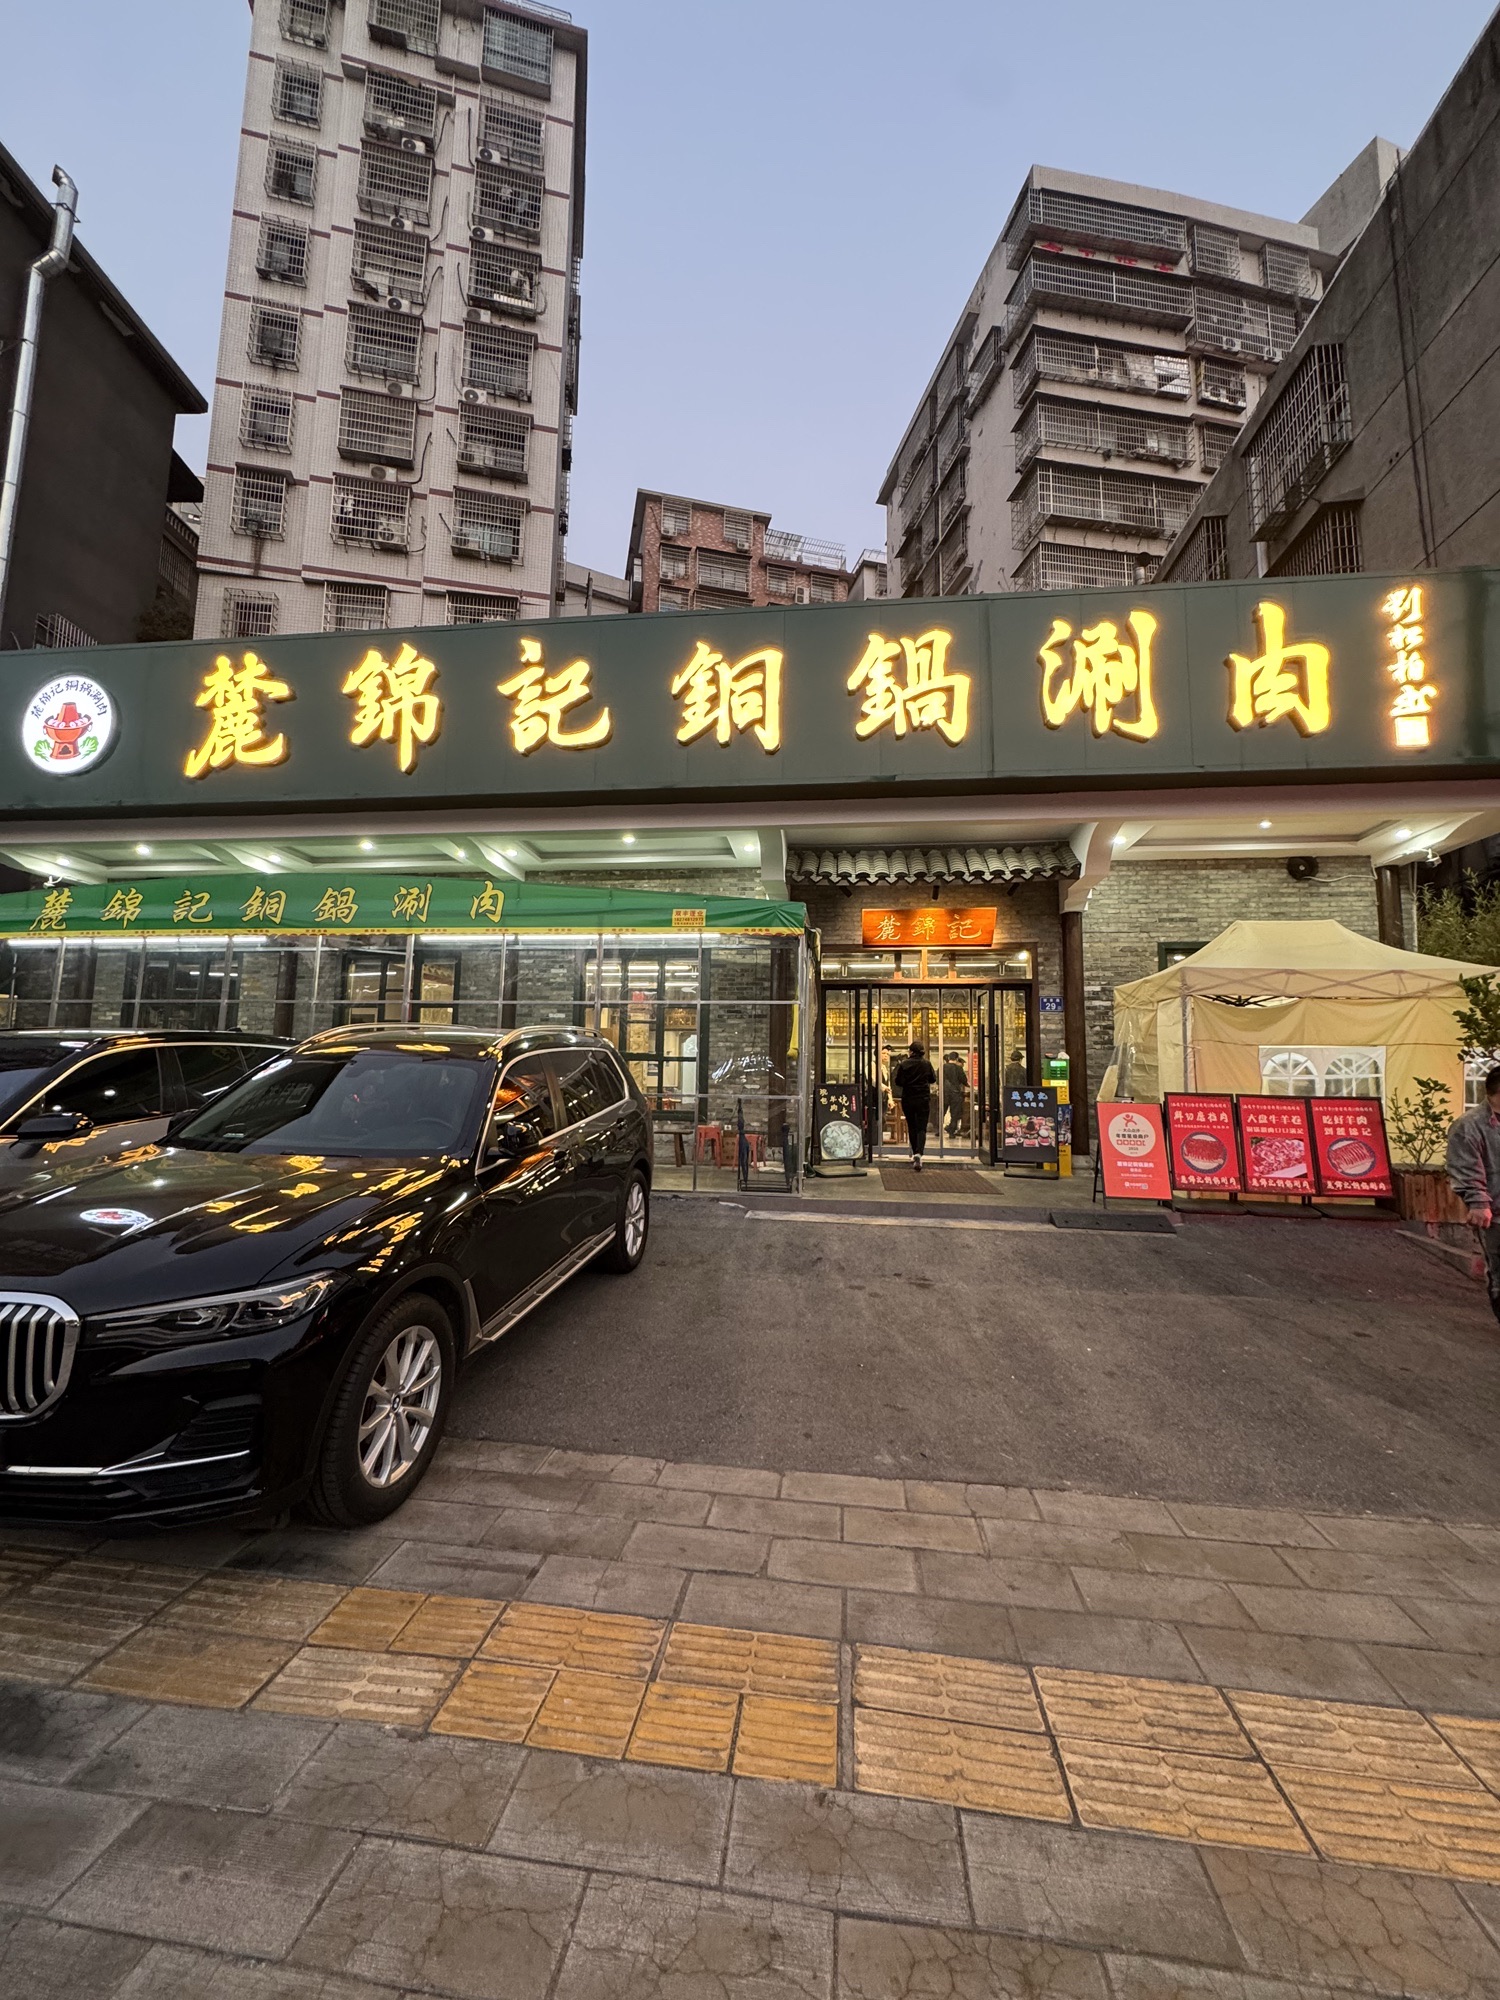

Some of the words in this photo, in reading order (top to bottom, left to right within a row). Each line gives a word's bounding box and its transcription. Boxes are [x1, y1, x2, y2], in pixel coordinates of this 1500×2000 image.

[185, 601, 1331, 777] 麓錦記銅鍋涮肉
[30, 880, 505, 931] 麓錦記銅鍋涮肉
[874, 914, 982, 940] 麓錦記
[1045, 1002, 1056, 1010] 29
